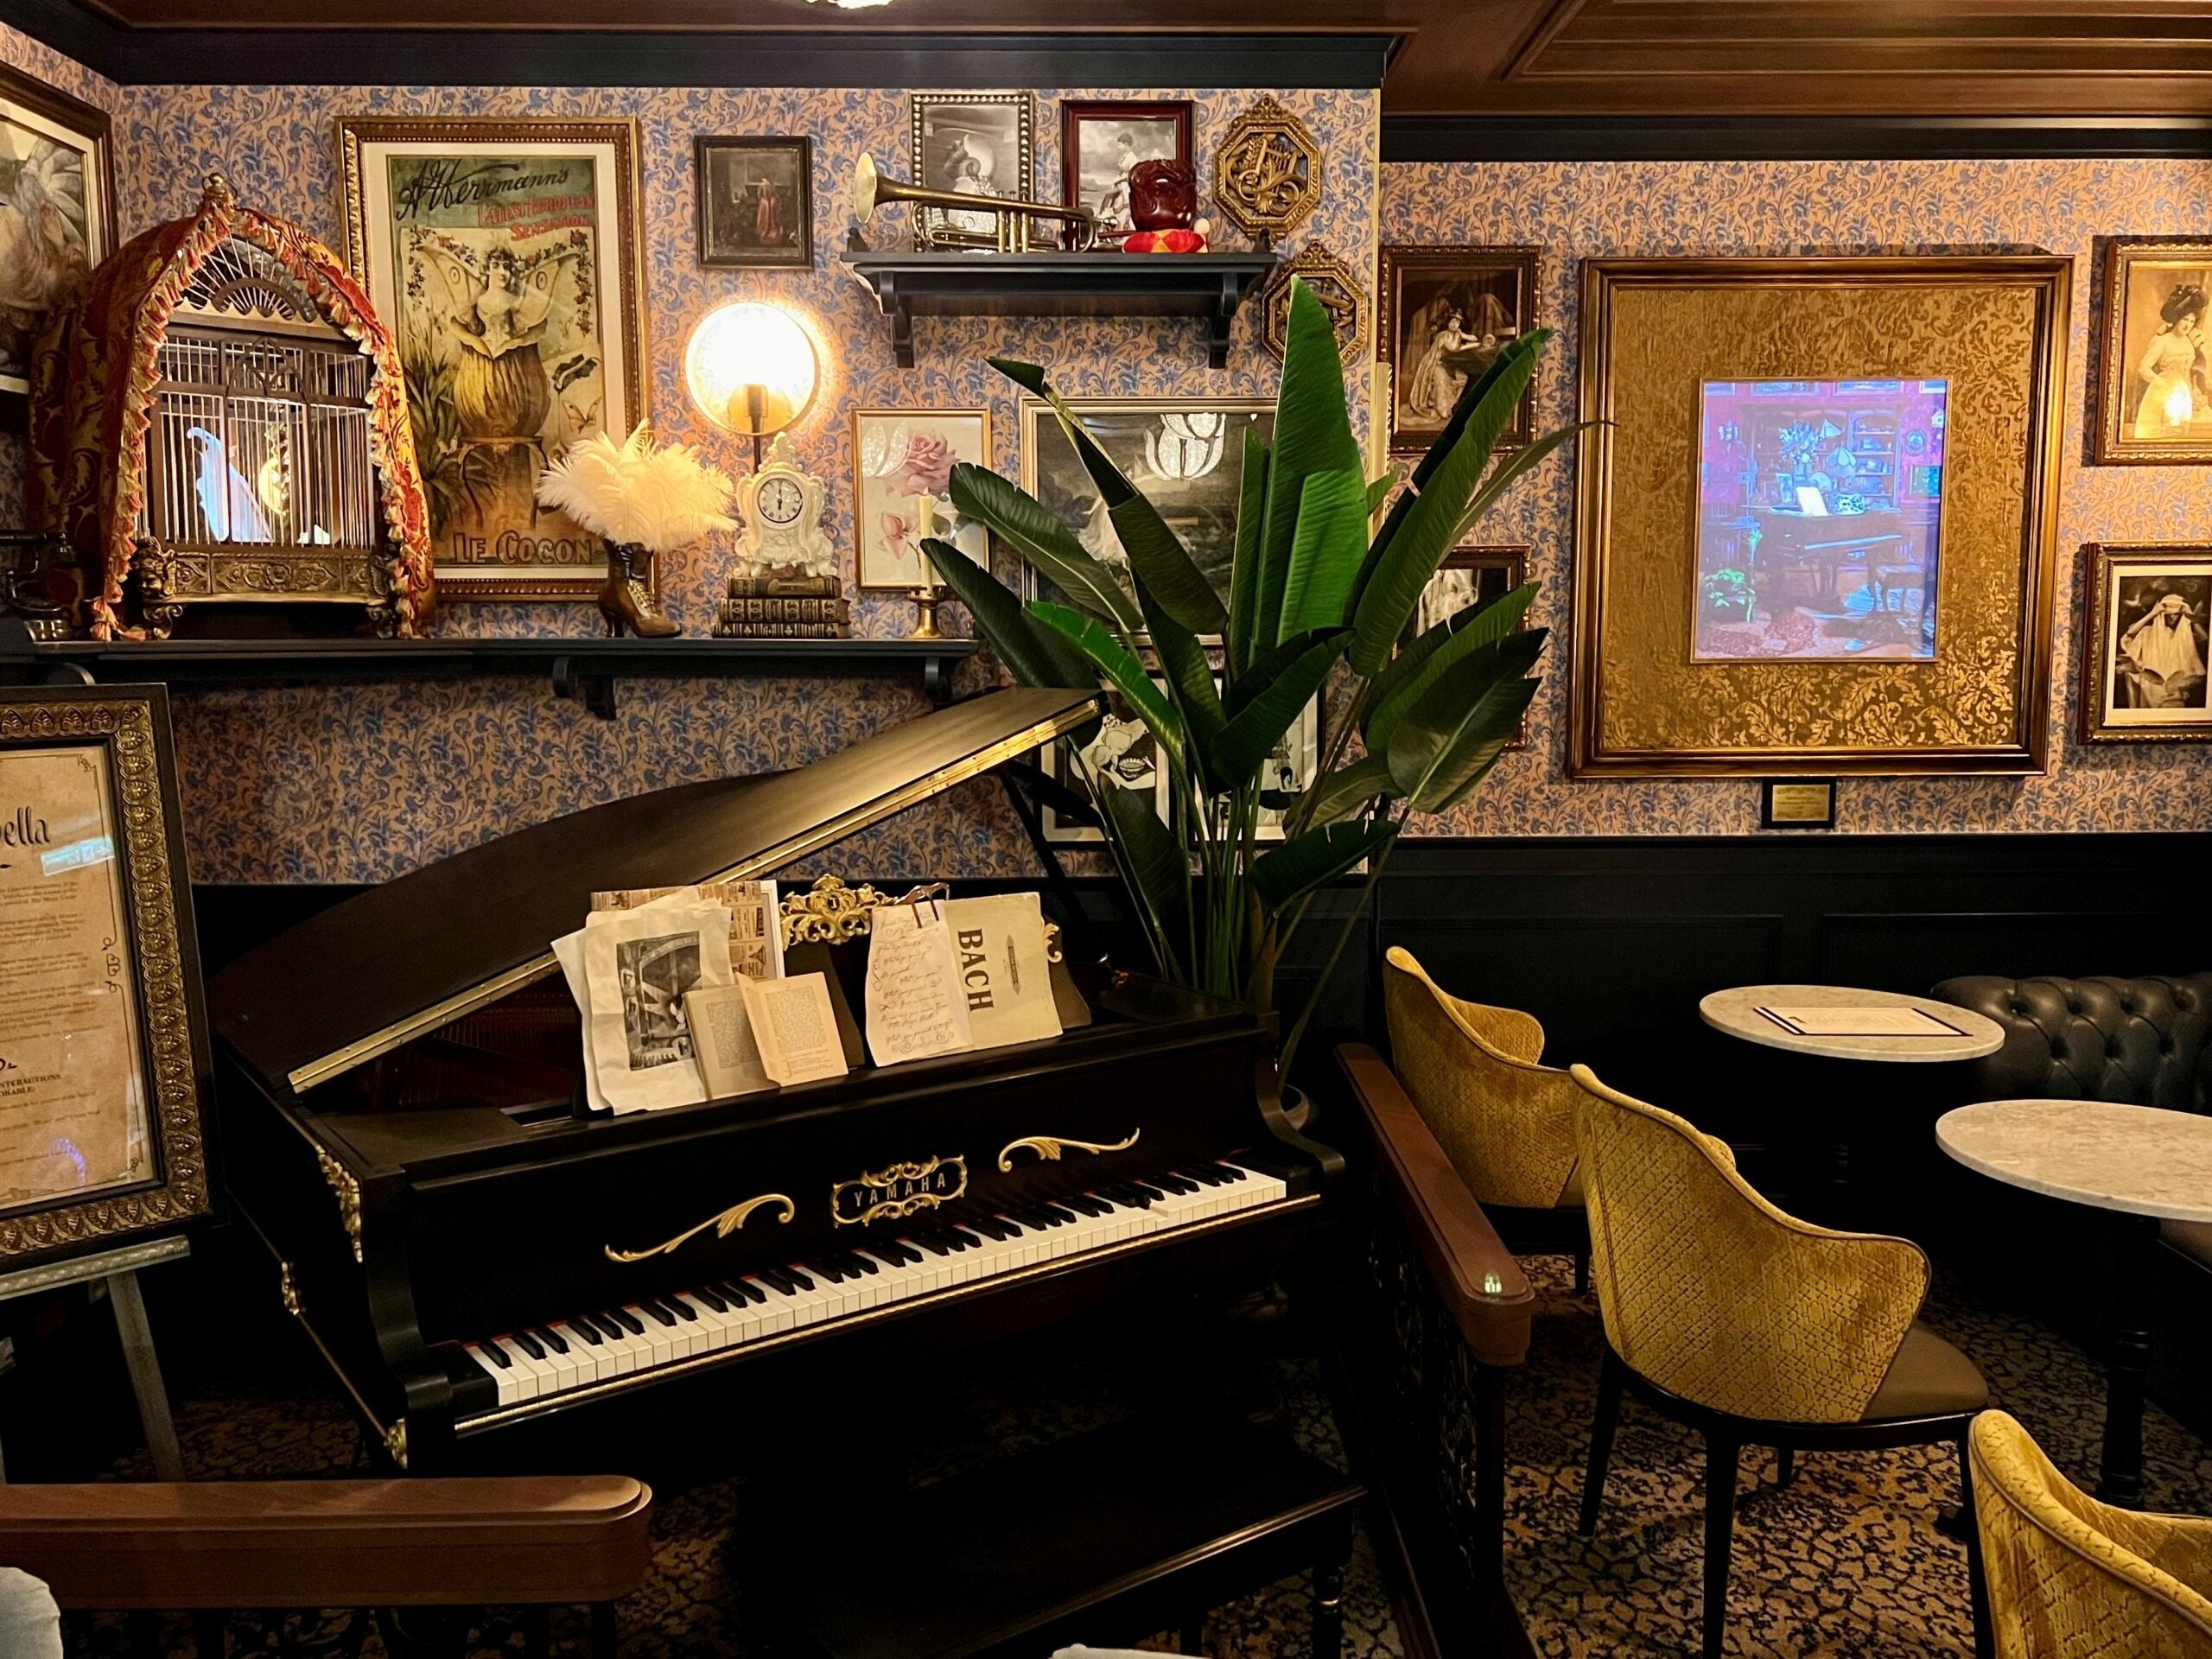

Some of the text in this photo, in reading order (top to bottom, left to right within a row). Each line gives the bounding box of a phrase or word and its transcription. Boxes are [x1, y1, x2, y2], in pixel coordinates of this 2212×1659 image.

[453, 530, 593, 565] LE COCON
[0, 806, 50, 847] ella
[957, 929, 995, 1012] BACH
[854, 1173, 946, 1207] YAMAHA
